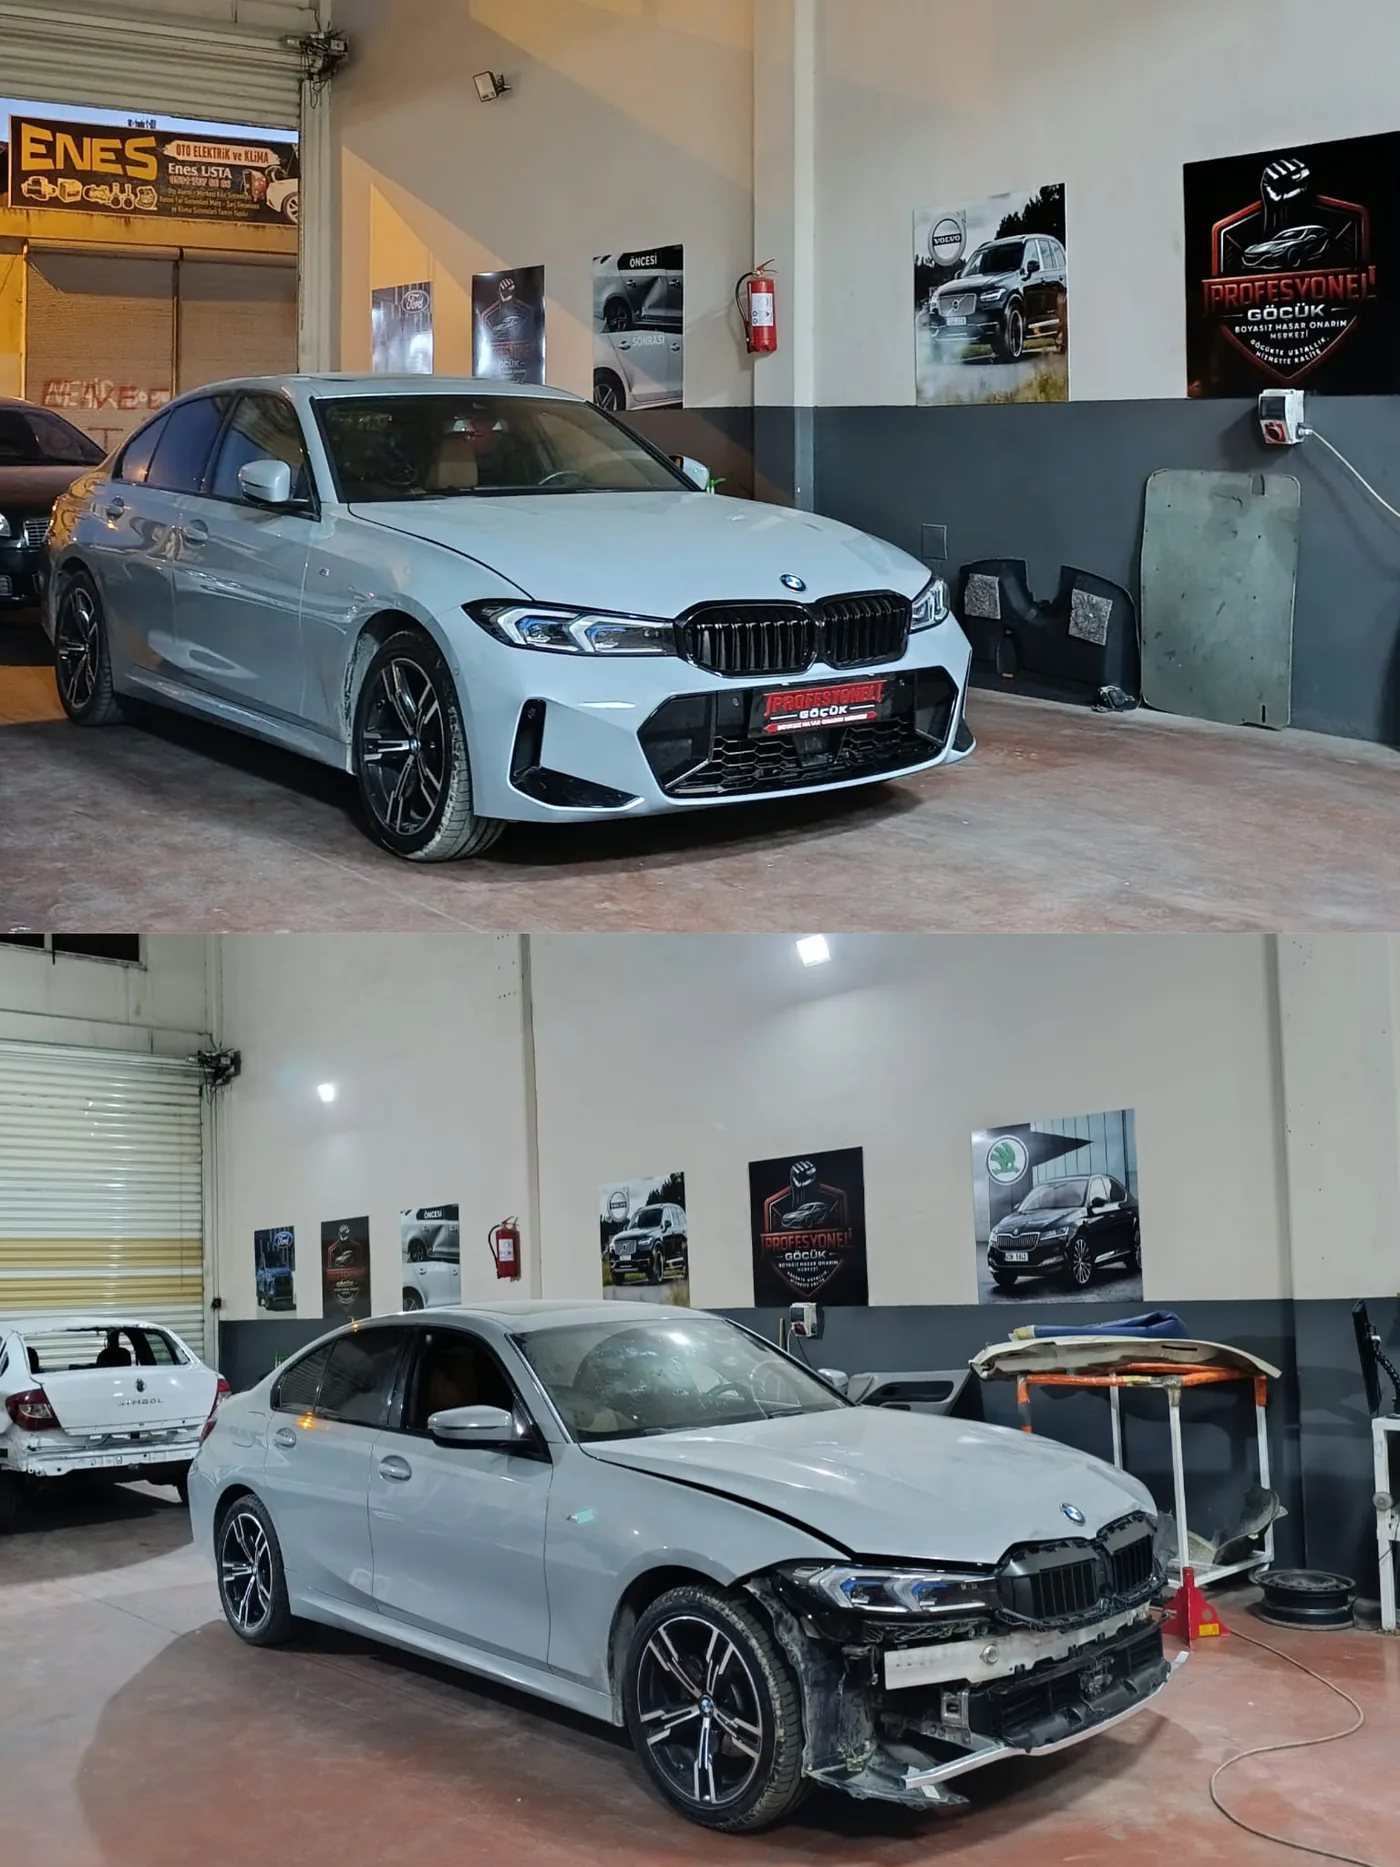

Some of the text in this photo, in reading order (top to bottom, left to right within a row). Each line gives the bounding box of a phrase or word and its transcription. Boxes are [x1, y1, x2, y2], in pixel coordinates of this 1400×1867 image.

[21, 122, 158, 181] ENES
[175, 143, 191, 157] OTO
[232, 151, 242, 161] ve
[167, 162, 232, 179] Enes USTA
[933, 235, 961, 245] VOLVO
[629, 253, 658, 268] ÖNCESİ
[406, 293, 424, 310] Ford
[1234, 320, 1347, 334] BOYASIZ HASAR ONARIM
[770, 683, 877, 713] PROFESYONEL
